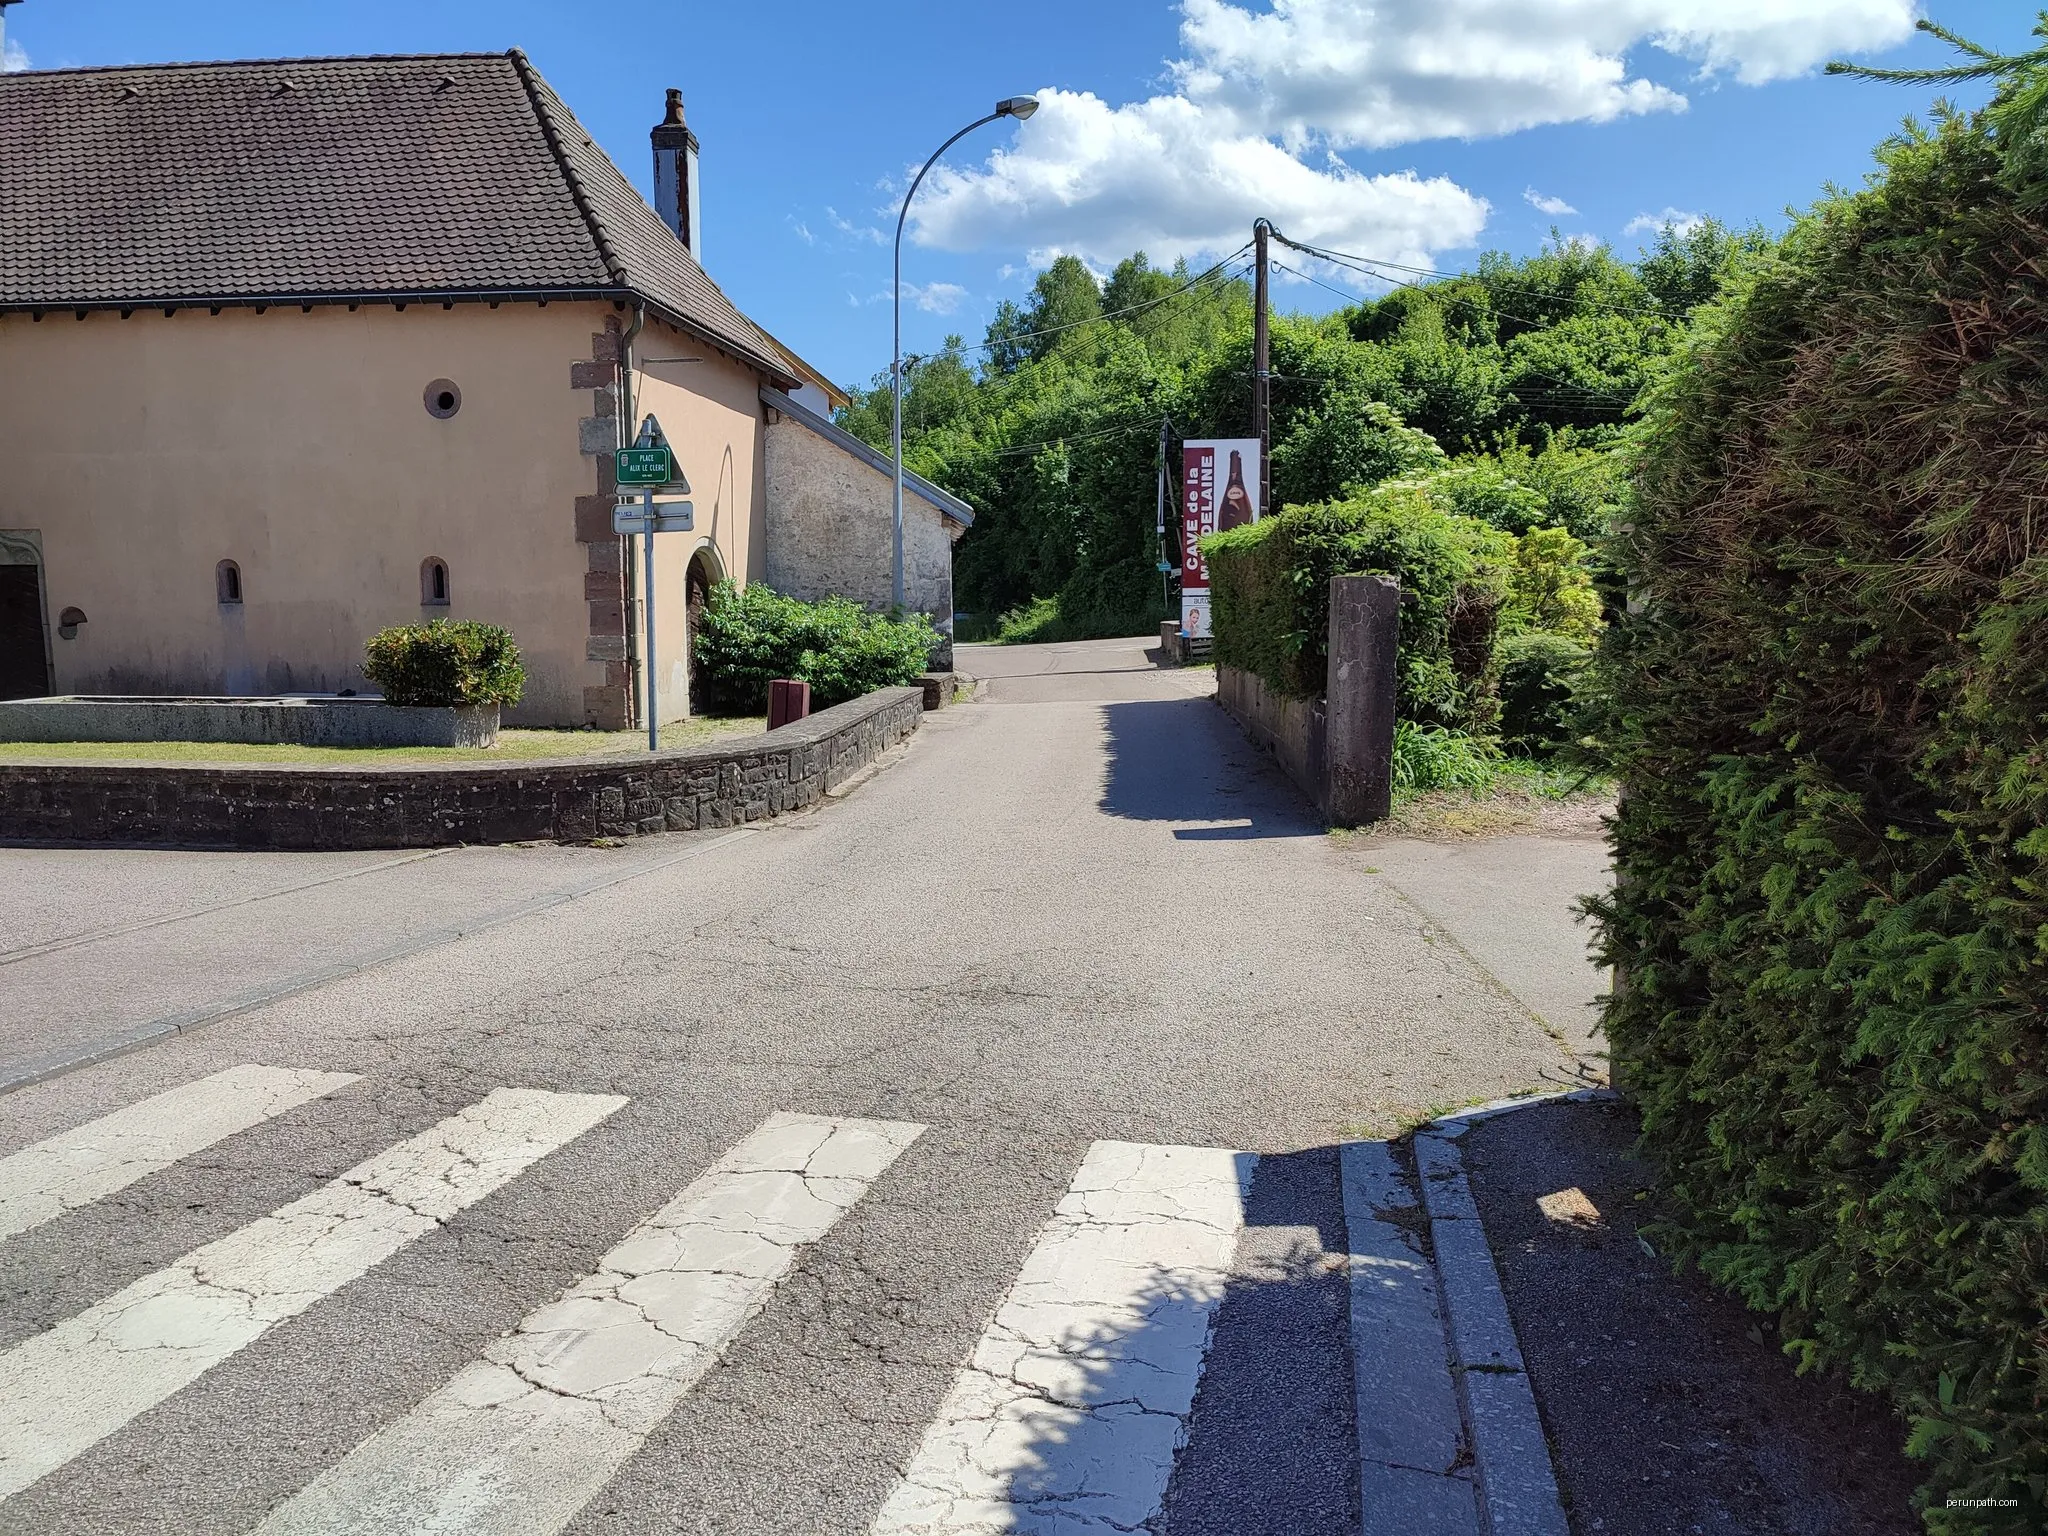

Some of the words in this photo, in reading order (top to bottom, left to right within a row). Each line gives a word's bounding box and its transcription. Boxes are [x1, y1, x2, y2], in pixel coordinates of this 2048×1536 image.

[639, 454, 654, 462] PLACE
[630, 464, 641, 472] ALIX
[1186, 467, 1199, 485] la
[1186, 490, 1199, 513] de
[1186, 519, 1199, 571] CAVE
